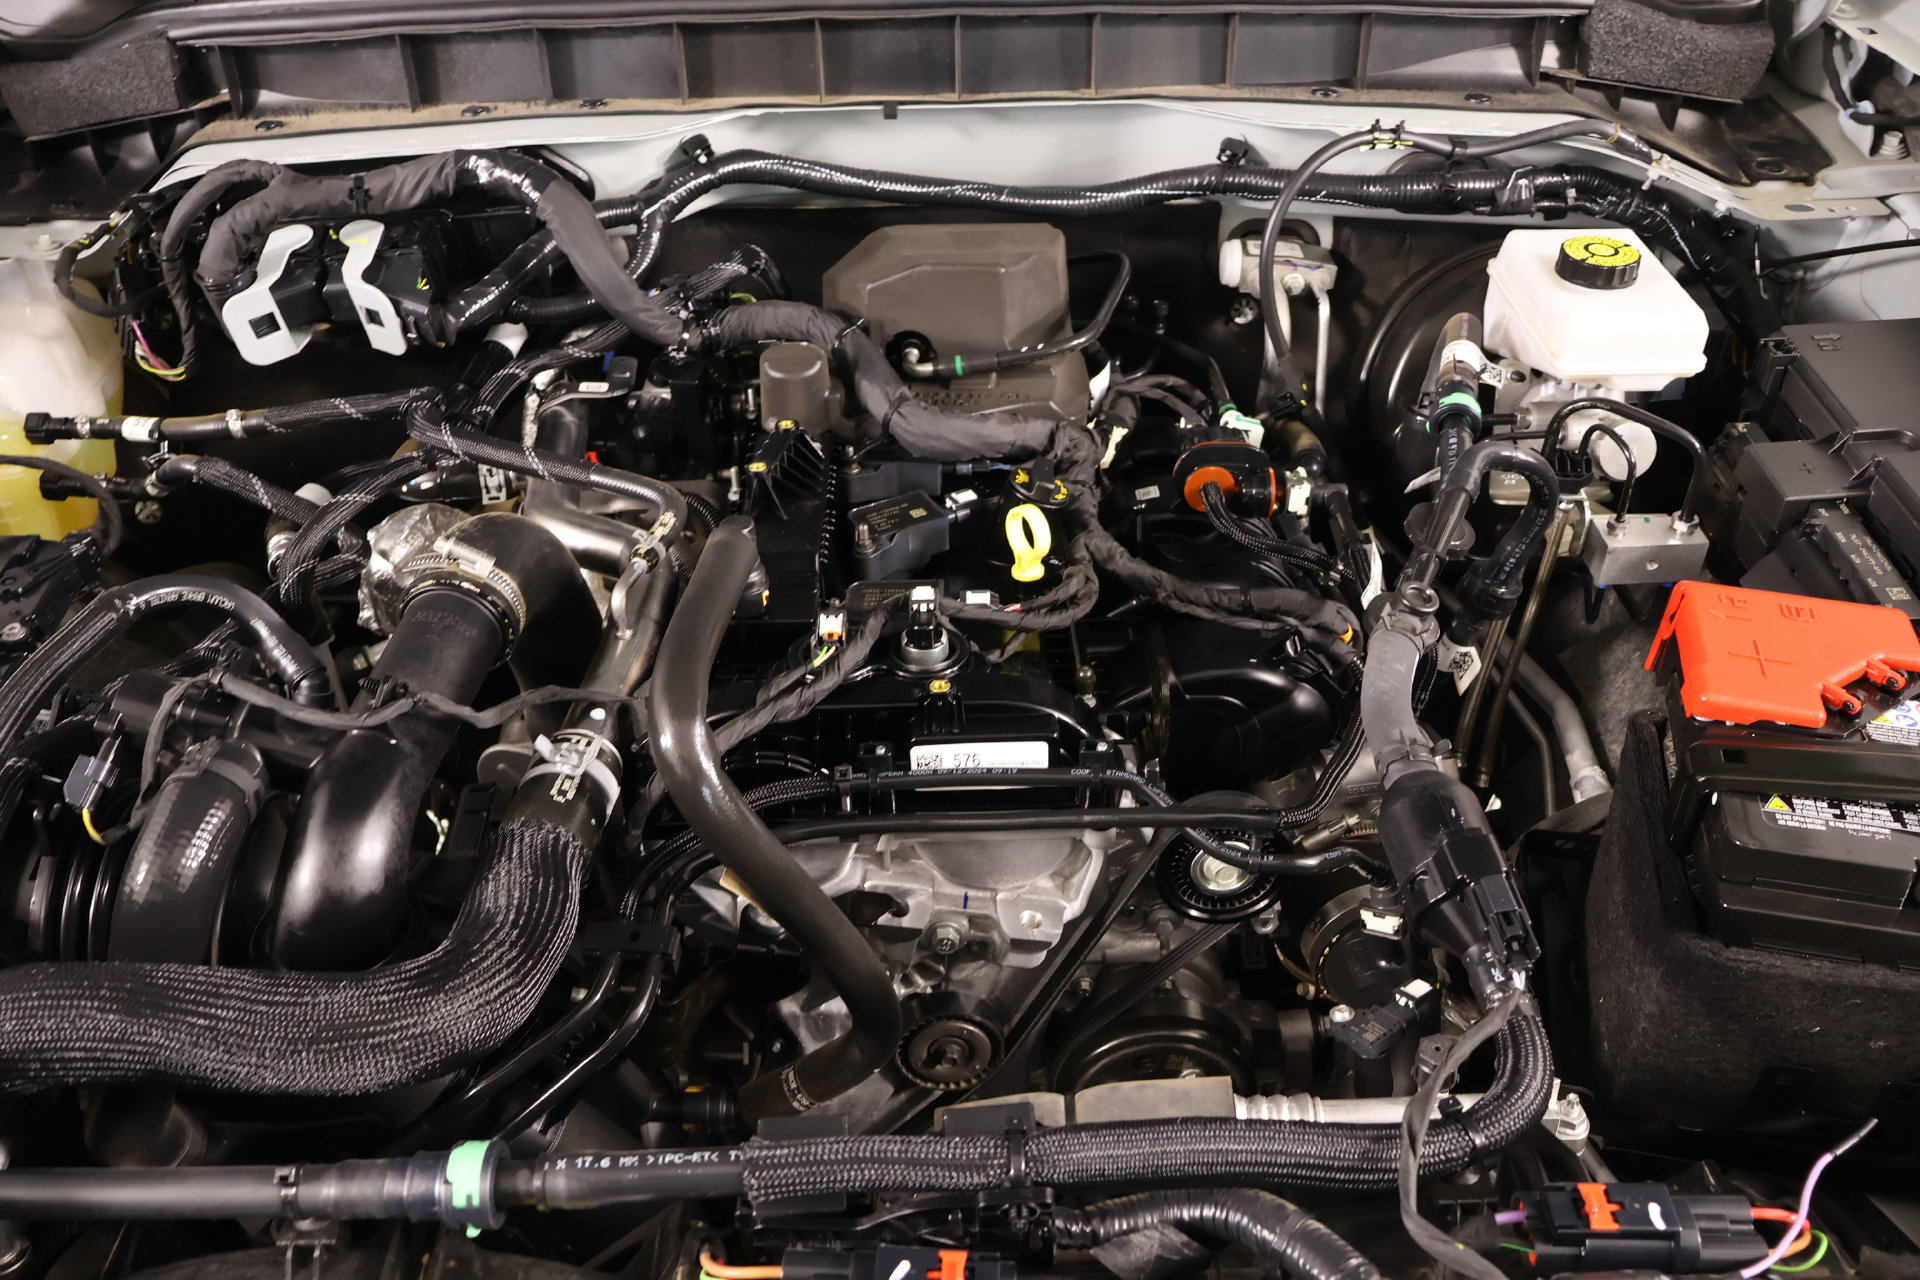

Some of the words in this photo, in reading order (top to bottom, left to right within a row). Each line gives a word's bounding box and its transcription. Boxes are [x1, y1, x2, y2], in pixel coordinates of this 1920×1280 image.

[953, 753, 981, 768] 576
[937, 767, 987, 776] 09/12/2024
[991, 766, 1018, 775] 09:19
[575, 1155, 612, 1169] 17.6
